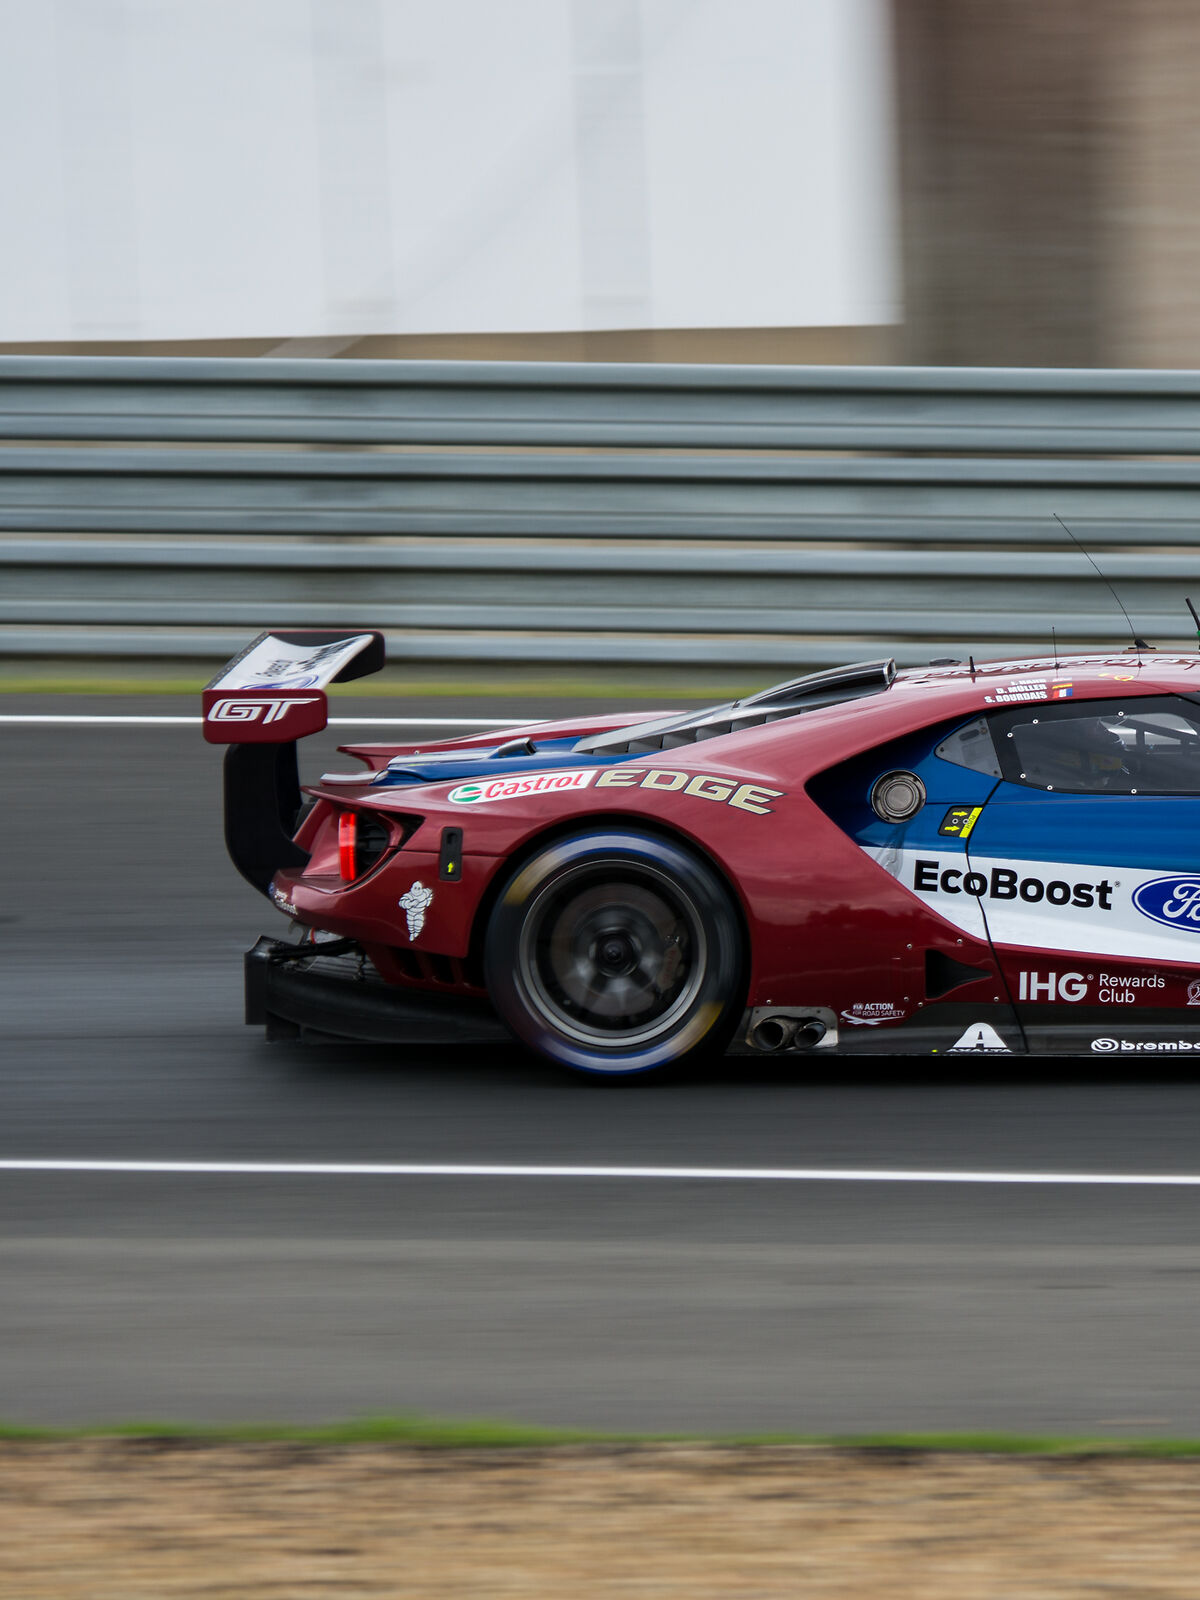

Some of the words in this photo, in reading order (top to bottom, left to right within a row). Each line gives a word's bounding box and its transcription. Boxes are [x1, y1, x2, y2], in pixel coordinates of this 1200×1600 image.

[996, 691, 1048, 703] BOURDAIS
[207, 698, 320, 725] GT
[485, 773, 584, 799] Castrol
[594, 769, 788, 815] EDGE
[1099, 974, 1166, 989] Rewards
[1099, 989, 1136, 1004] Club
